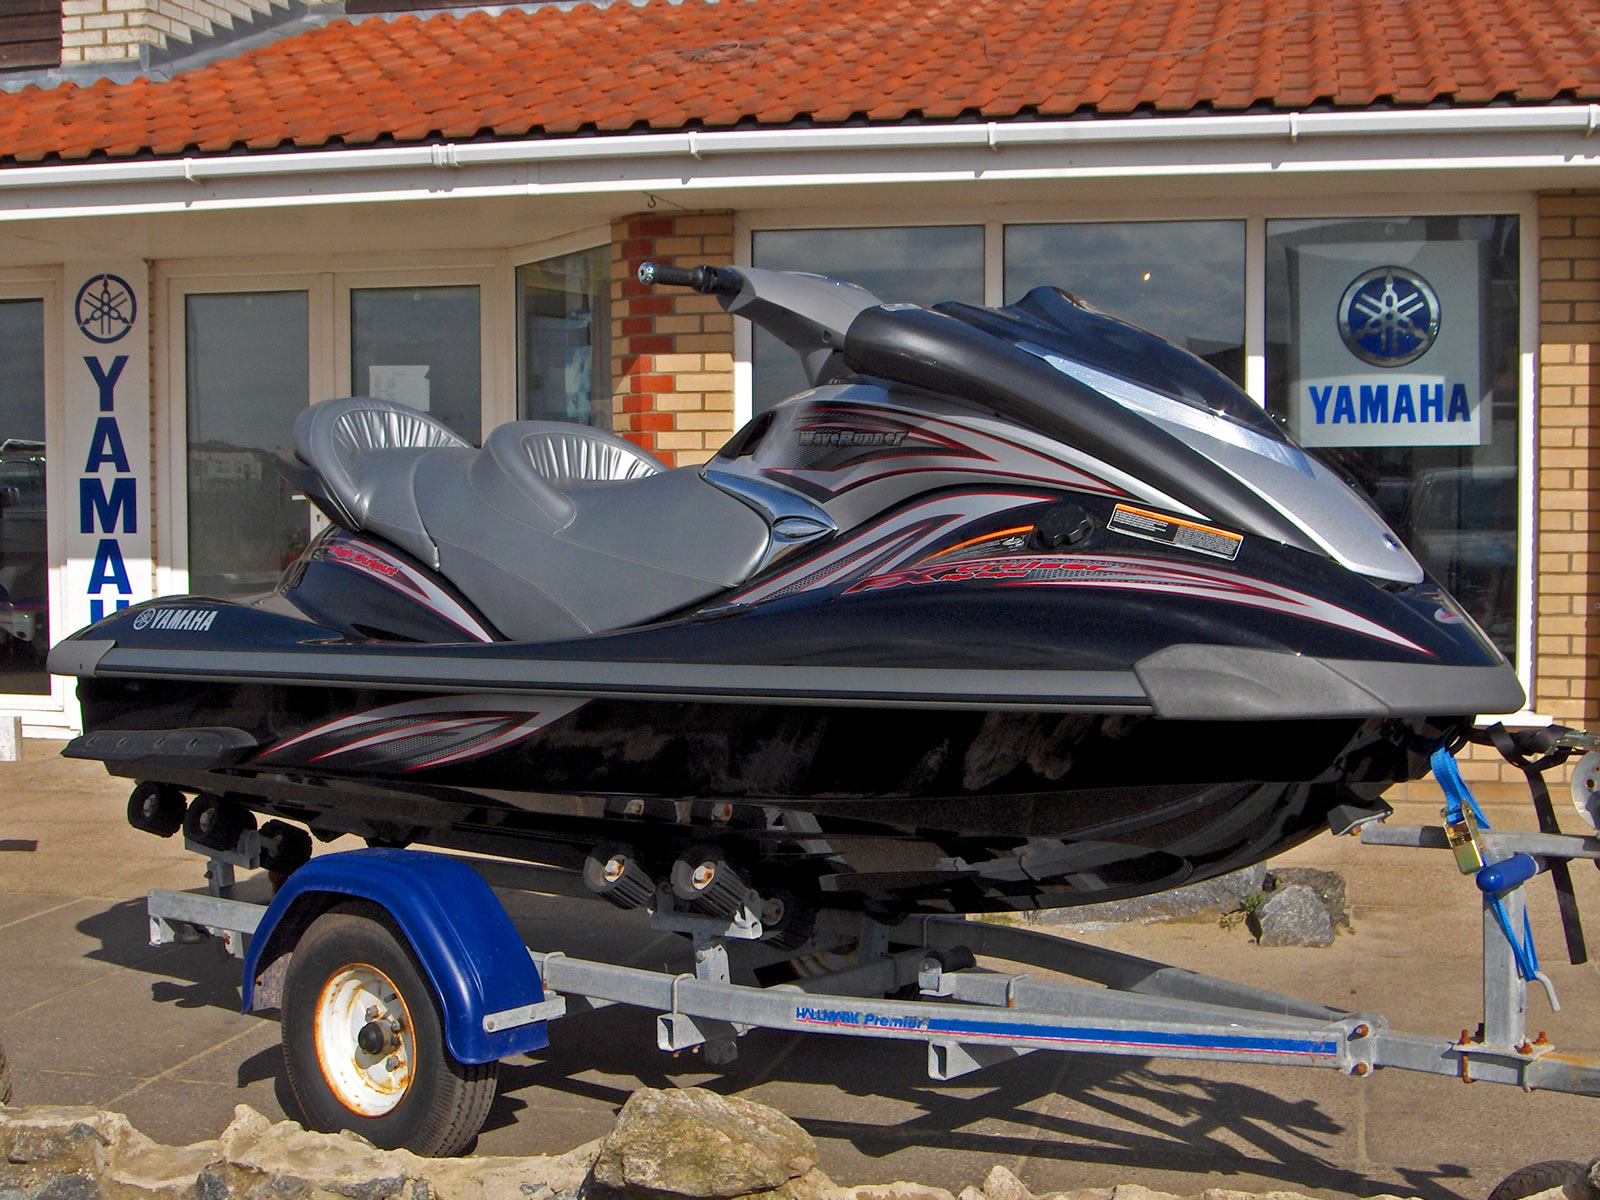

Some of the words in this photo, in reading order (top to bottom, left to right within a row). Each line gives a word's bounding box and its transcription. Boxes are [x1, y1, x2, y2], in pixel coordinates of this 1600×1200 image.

[1308, 384, 1471, 424] YAMAHA
[799, 430, 908, 447] WaveRunner
[353, 553, 399, 577] Output
[150, 609, 218, 631] YAMAHA
[796, 1007, 860, 1025] HALLMARK
[864, 1013, 924, 1029] Premier
